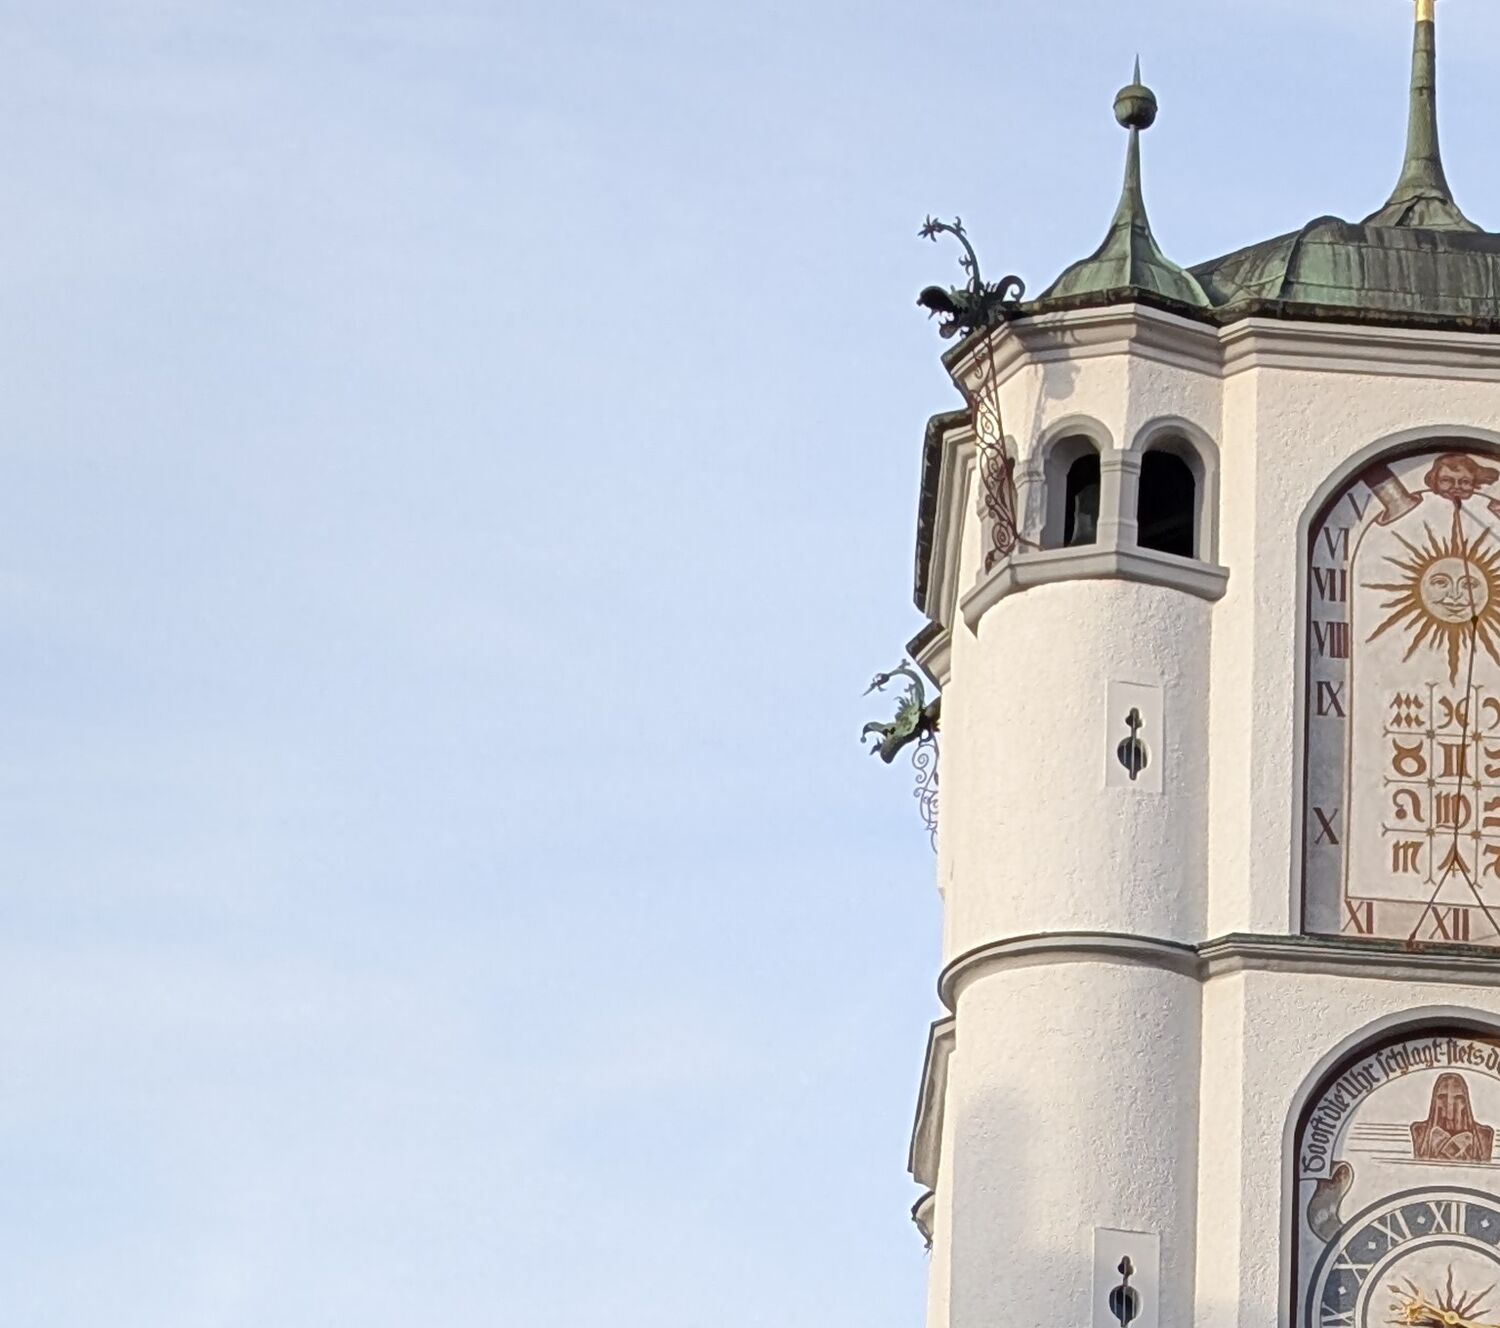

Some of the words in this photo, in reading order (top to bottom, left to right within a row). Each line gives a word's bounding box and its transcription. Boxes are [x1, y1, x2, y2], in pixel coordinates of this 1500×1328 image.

[1347, 492, 1372, 523] V
[1323, 526, 1350, 561] VI
[1311, 566, 1348, 602] VII
[1315, 680, 1346, 718] IX
[1312, 806, 1340, 845] X
[1341, 898, 1374, 935] XI
[1428, 906, 1470, 942] XII
[1370, 1209, 1412, 1251] XI
[1426, 1201, 1467, 1235] XII
[1332, 1249, 1375, 1287] X
